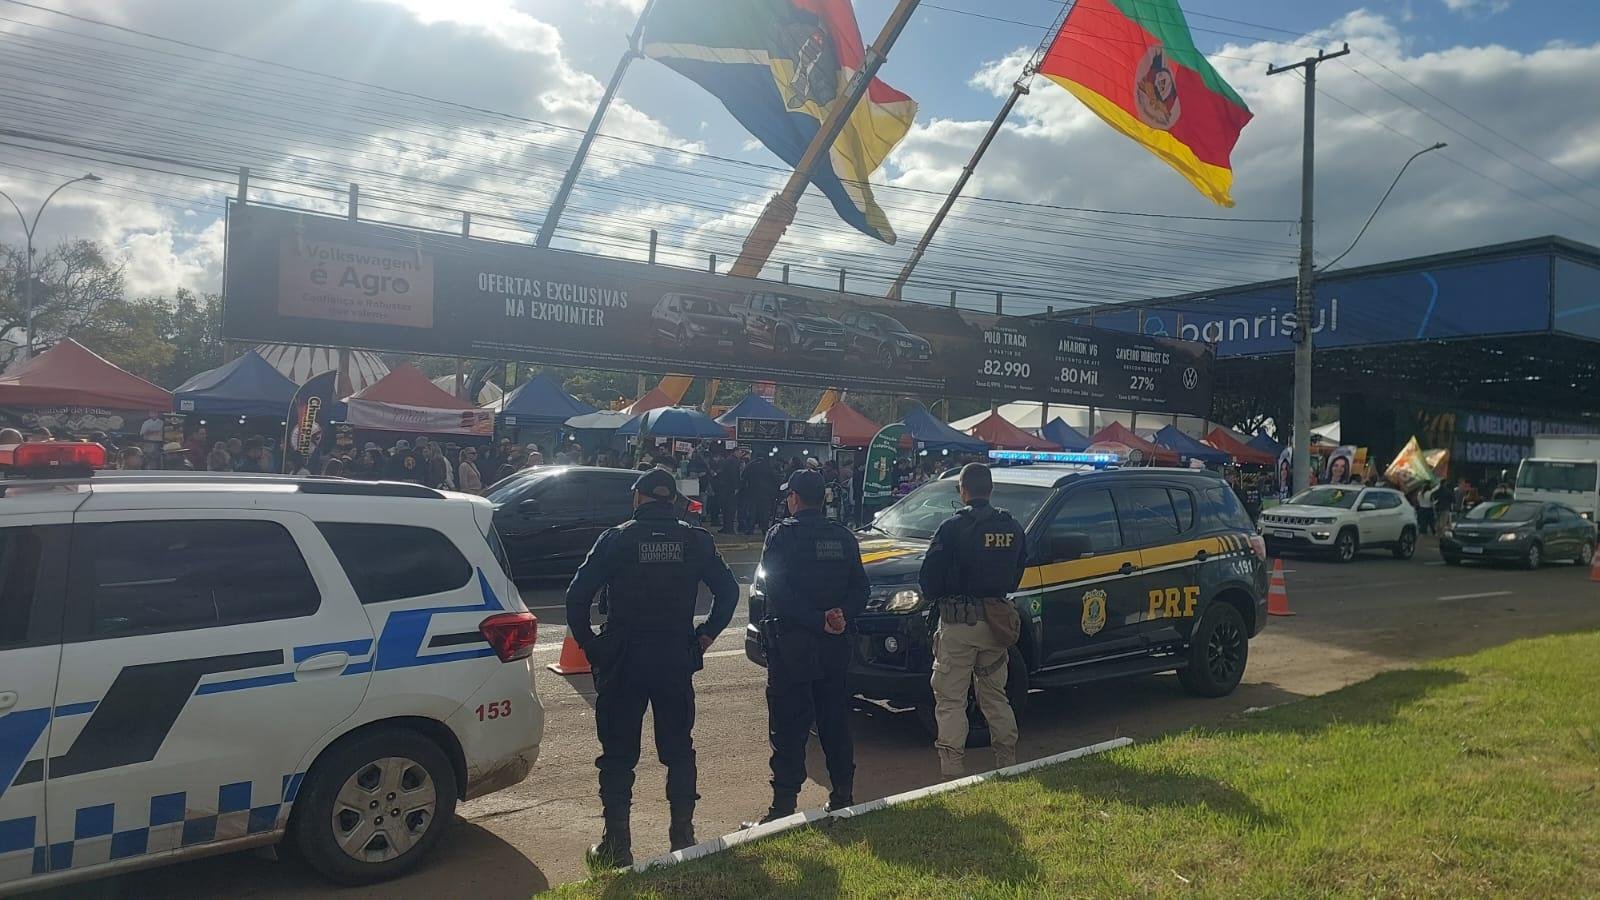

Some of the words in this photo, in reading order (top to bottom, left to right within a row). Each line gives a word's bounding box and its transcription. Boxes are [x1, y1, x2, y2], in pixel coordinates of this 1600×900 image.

[306, 244, 412, 270] Volkswagen
[310, 261, 328, 286] é
[338, 266, 410, 296] Agro
[478, 272, 541, 298] OFERTAS
[546, 281, 629, 309] EXCLUSIVAS
[505, 298, 525, 317] NA
[531, 301, 605, 326] EXPOINTER
[984, 331, 1001, 345] POLO
[1003, 333, 1027, 348] TRACK
[1058, 339, 1087, 355] AMAROK
[1089, 343, 1098, 357] V6
[1115, 348, 1140, 362] SAVEIRO
[1140, 350, 1161, 364] ROBUST
[1162, 353, 1170, 365] CS
[984, 359, 1031, 378] 82.990
[1061, 367, 1078, 383] 80
[1080, 369, 1098, 386] Mil
[1130, 375, 1155, 391] 27%
[1466, 415, 1476, 432] A
[1479, 416, 1529, 437] MELHOR
[641, 543, 681, 552] GUARDA
[985, 533, 1014, 547] PRF
[640, 552, 681, 561] MUNICIPAL
[1238, 559, 1253, 575] 191
[1147, 586, 1201, 620] PRF
[475, 700, 512, 722] 153
